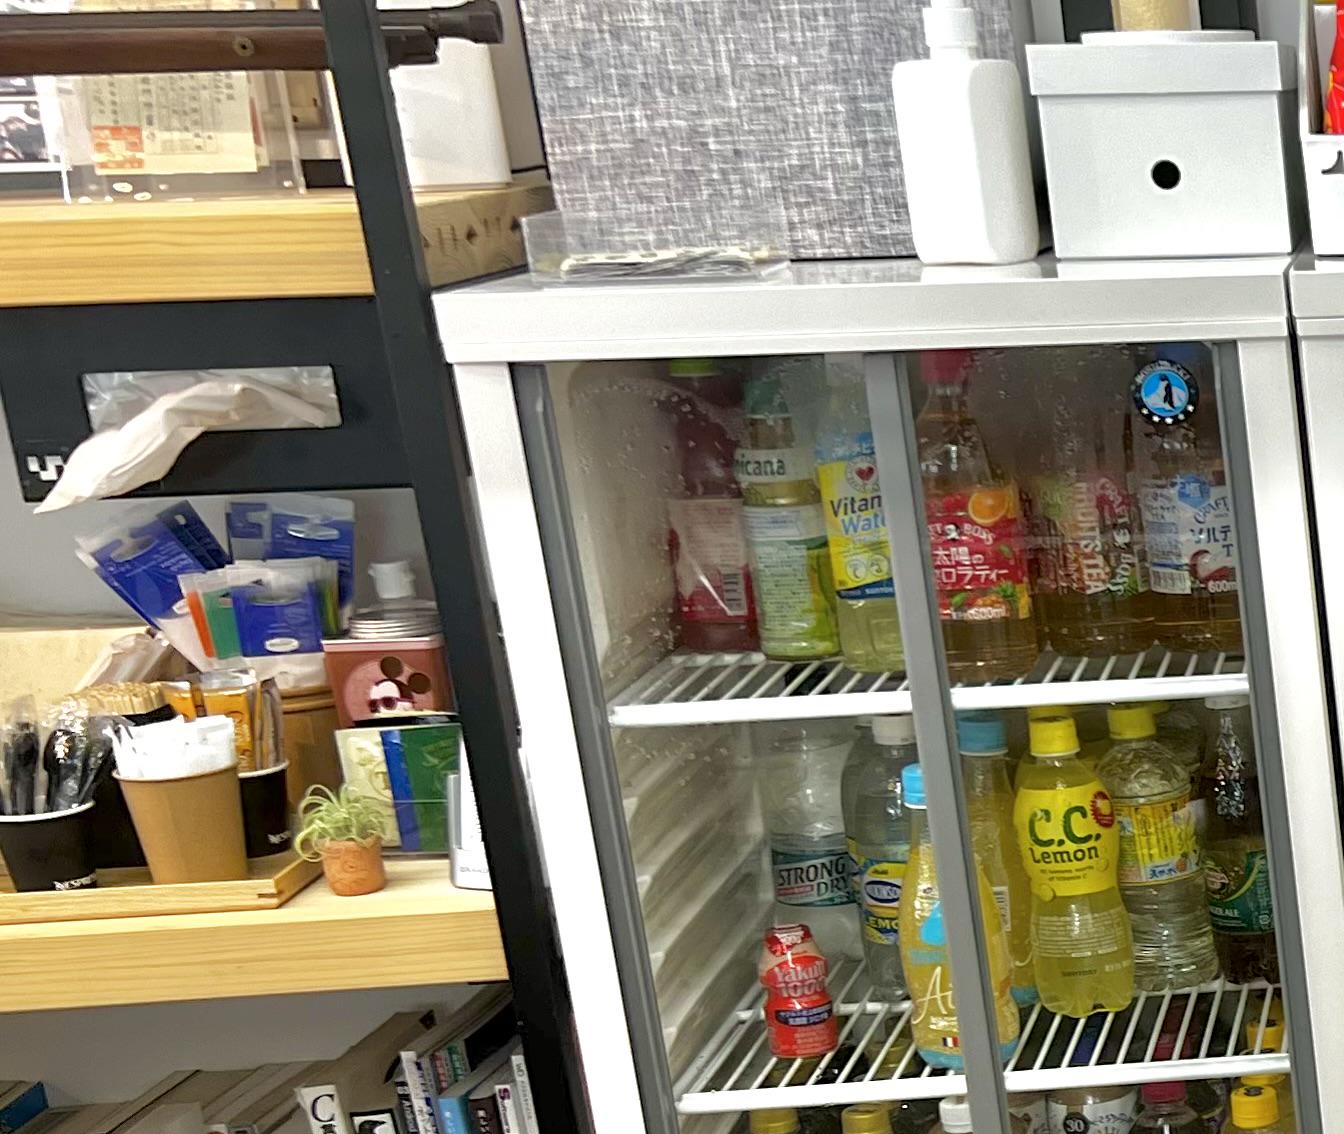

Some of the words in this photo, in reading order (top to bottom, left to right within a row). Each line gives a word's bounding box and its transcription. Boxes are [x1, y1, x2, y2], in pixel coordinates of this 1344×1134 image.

[934, 546, 985, 566] 太陽の
[1028, 804, 1102, 848] C.C.
[1029, 845, 1100, 866] Lemon
[777, 856, 847, 887] STRONG
[816, 876, 852, 897] DRY
